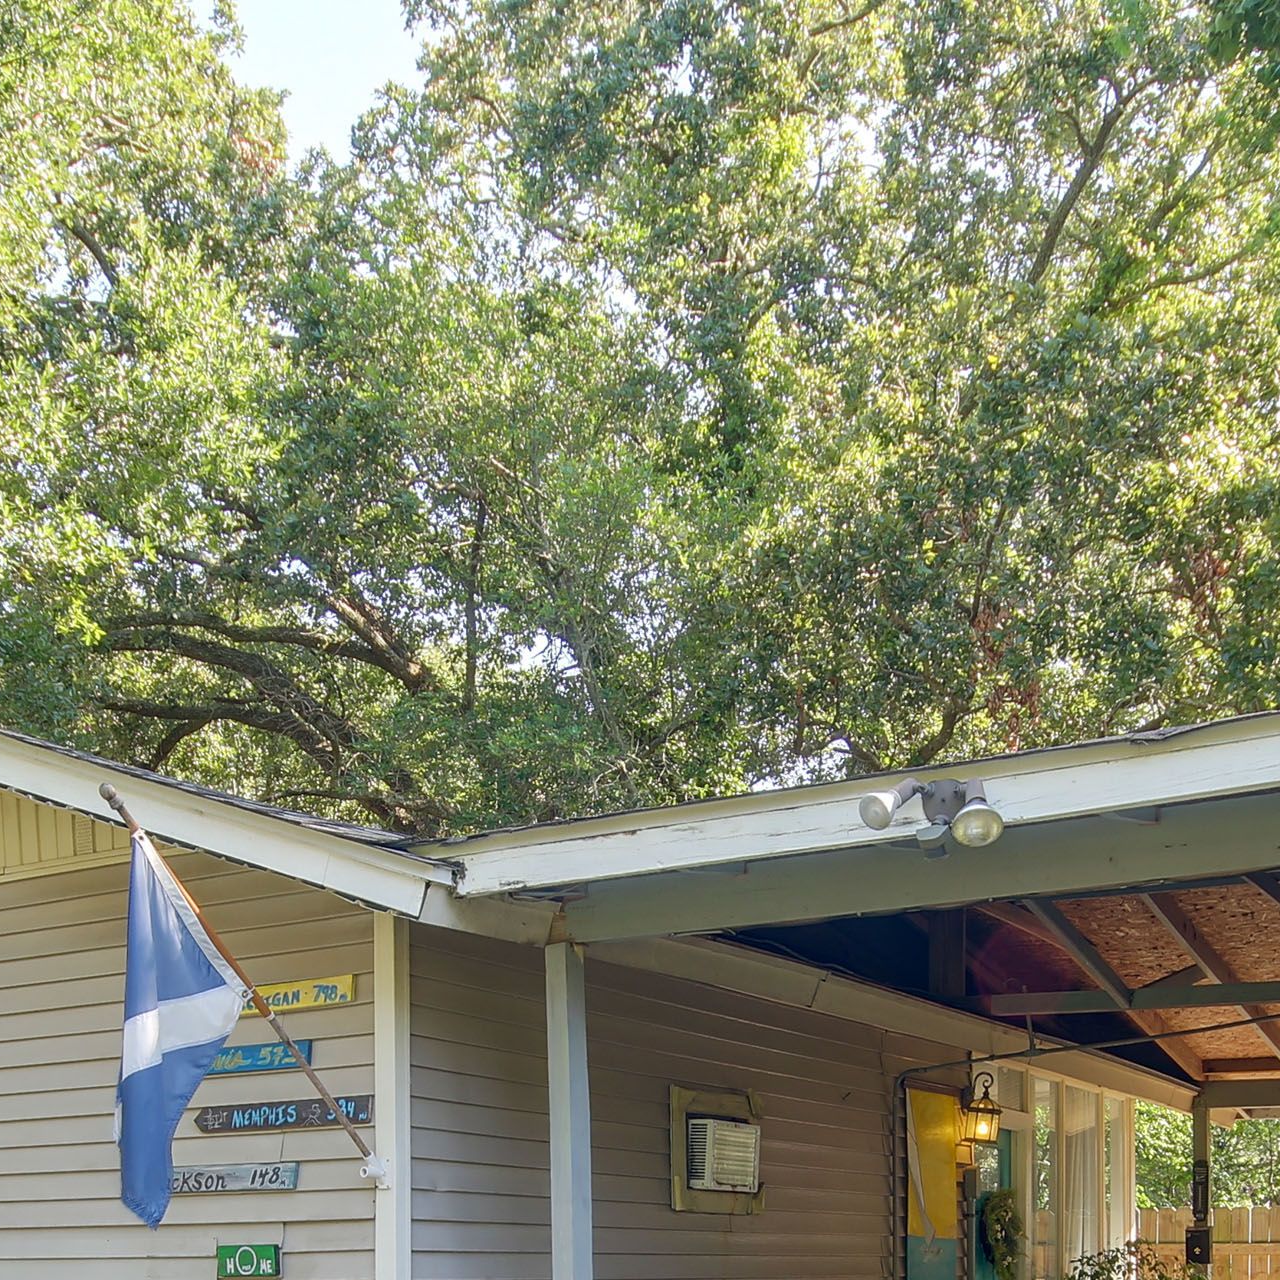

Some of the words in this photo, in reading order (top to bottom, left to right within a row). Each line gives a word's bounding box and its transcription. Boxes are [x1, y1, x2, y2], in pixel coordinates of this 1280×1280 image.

[313, 984, 338, 1004] 798
[231, 1104, 297, 1129] MEMPHIS
[248, 1166, 281, 1188] 148
